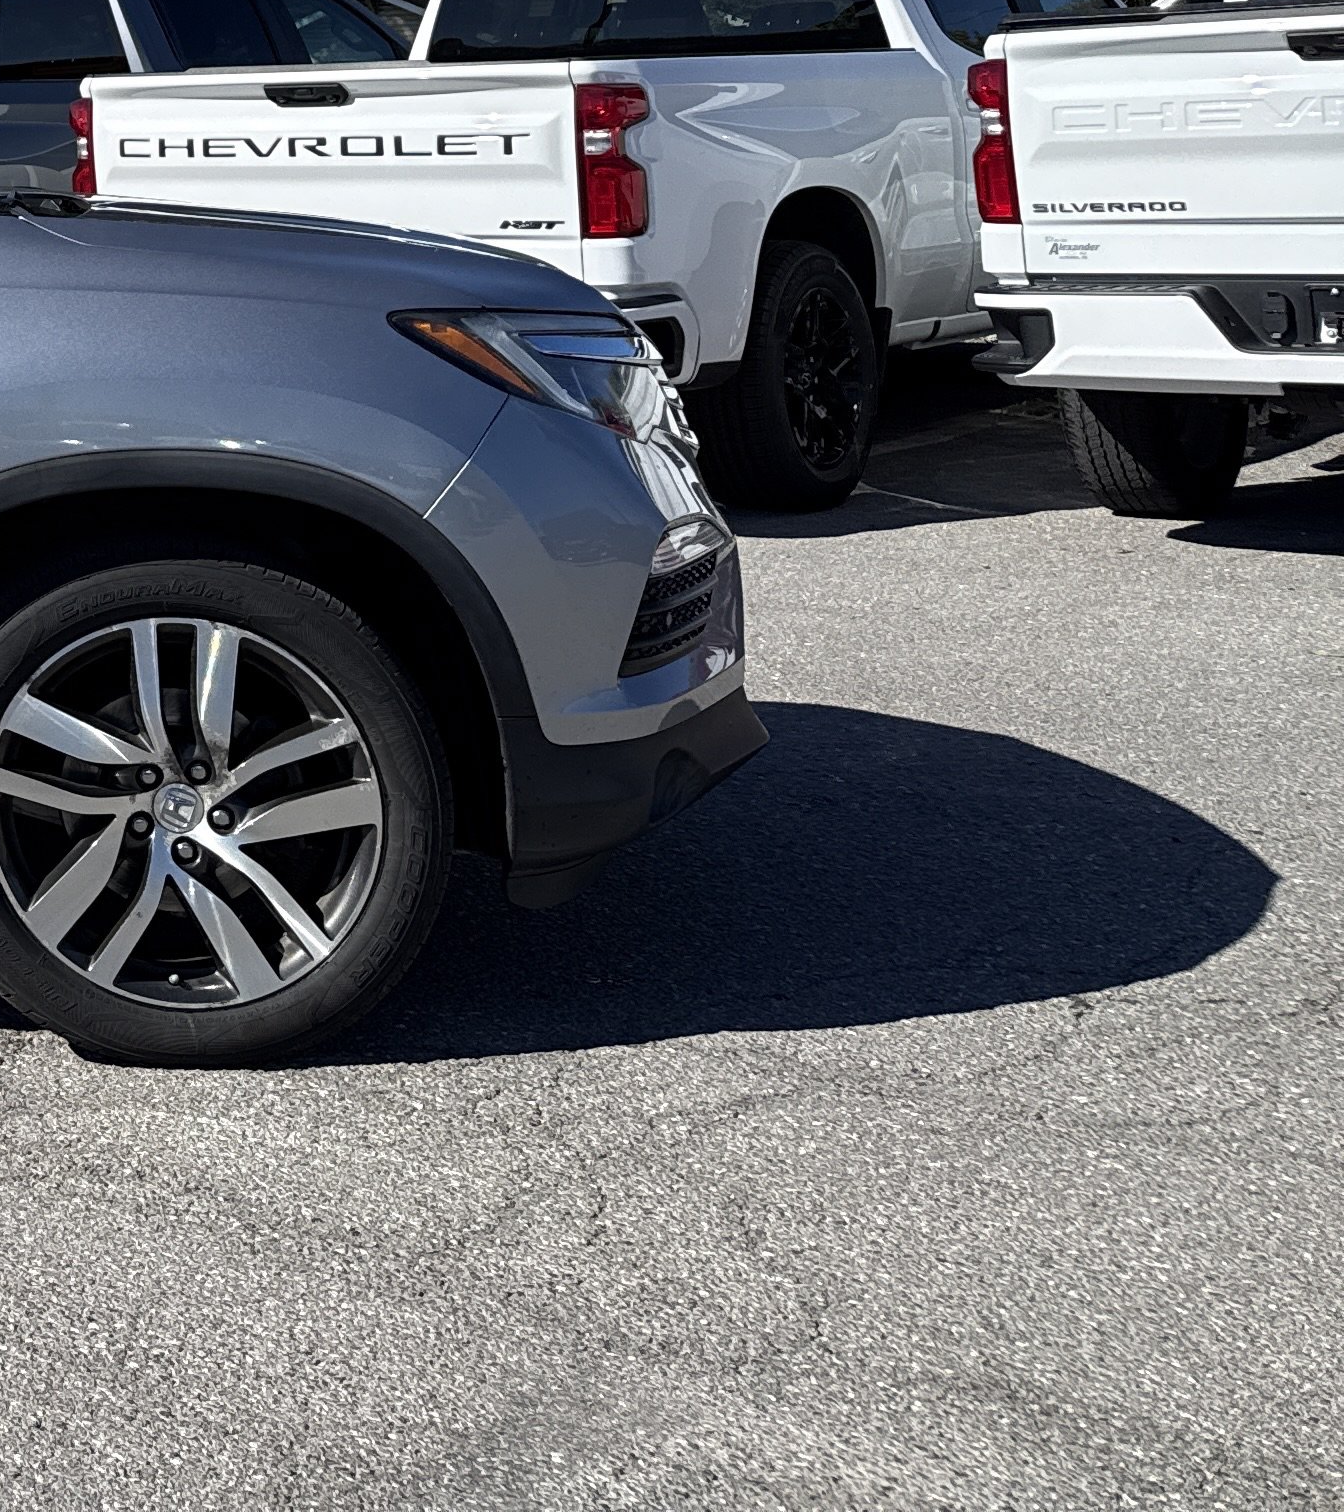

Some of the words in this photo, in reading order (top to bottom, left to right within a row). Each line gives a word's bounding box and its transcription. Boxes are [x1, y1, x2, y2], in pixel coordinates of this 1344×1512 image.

[119, 133, 531, 158] CHEVROLET
[1032, 201, 1188, 213] SILVERADO
[1048, 242, 1100, 255] Alexander
[349, 824, 428, 988] COOPER
